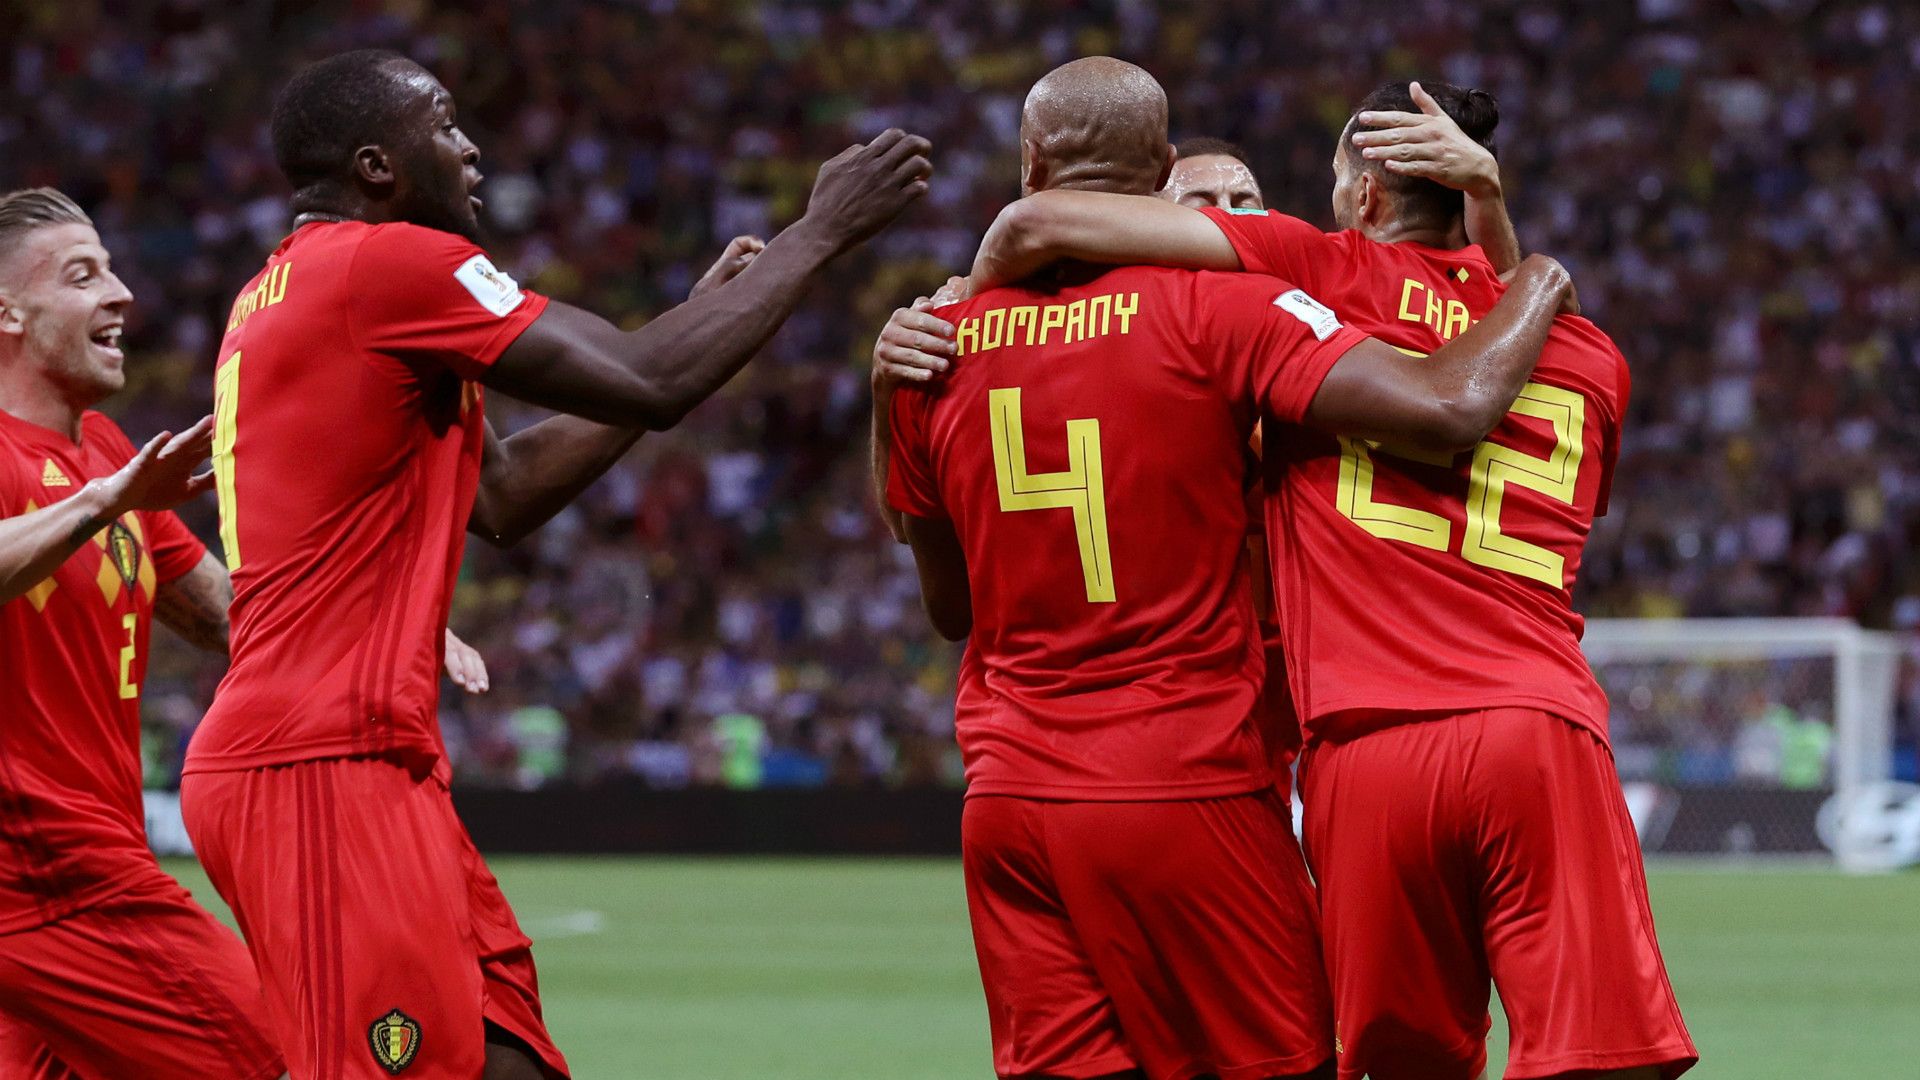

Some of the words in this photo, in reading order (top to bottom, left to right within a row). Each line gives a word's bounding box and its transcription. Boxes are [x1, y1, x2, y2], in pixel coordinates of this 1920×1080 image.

[956, 292, 1140, 357] KOMPANY
[1397, 278, 1480, 339] CHA
[988, 387, 1117, 603] 4
[1334, 346, 1586, 590] 22
[119, 612, 139, 700] 2
